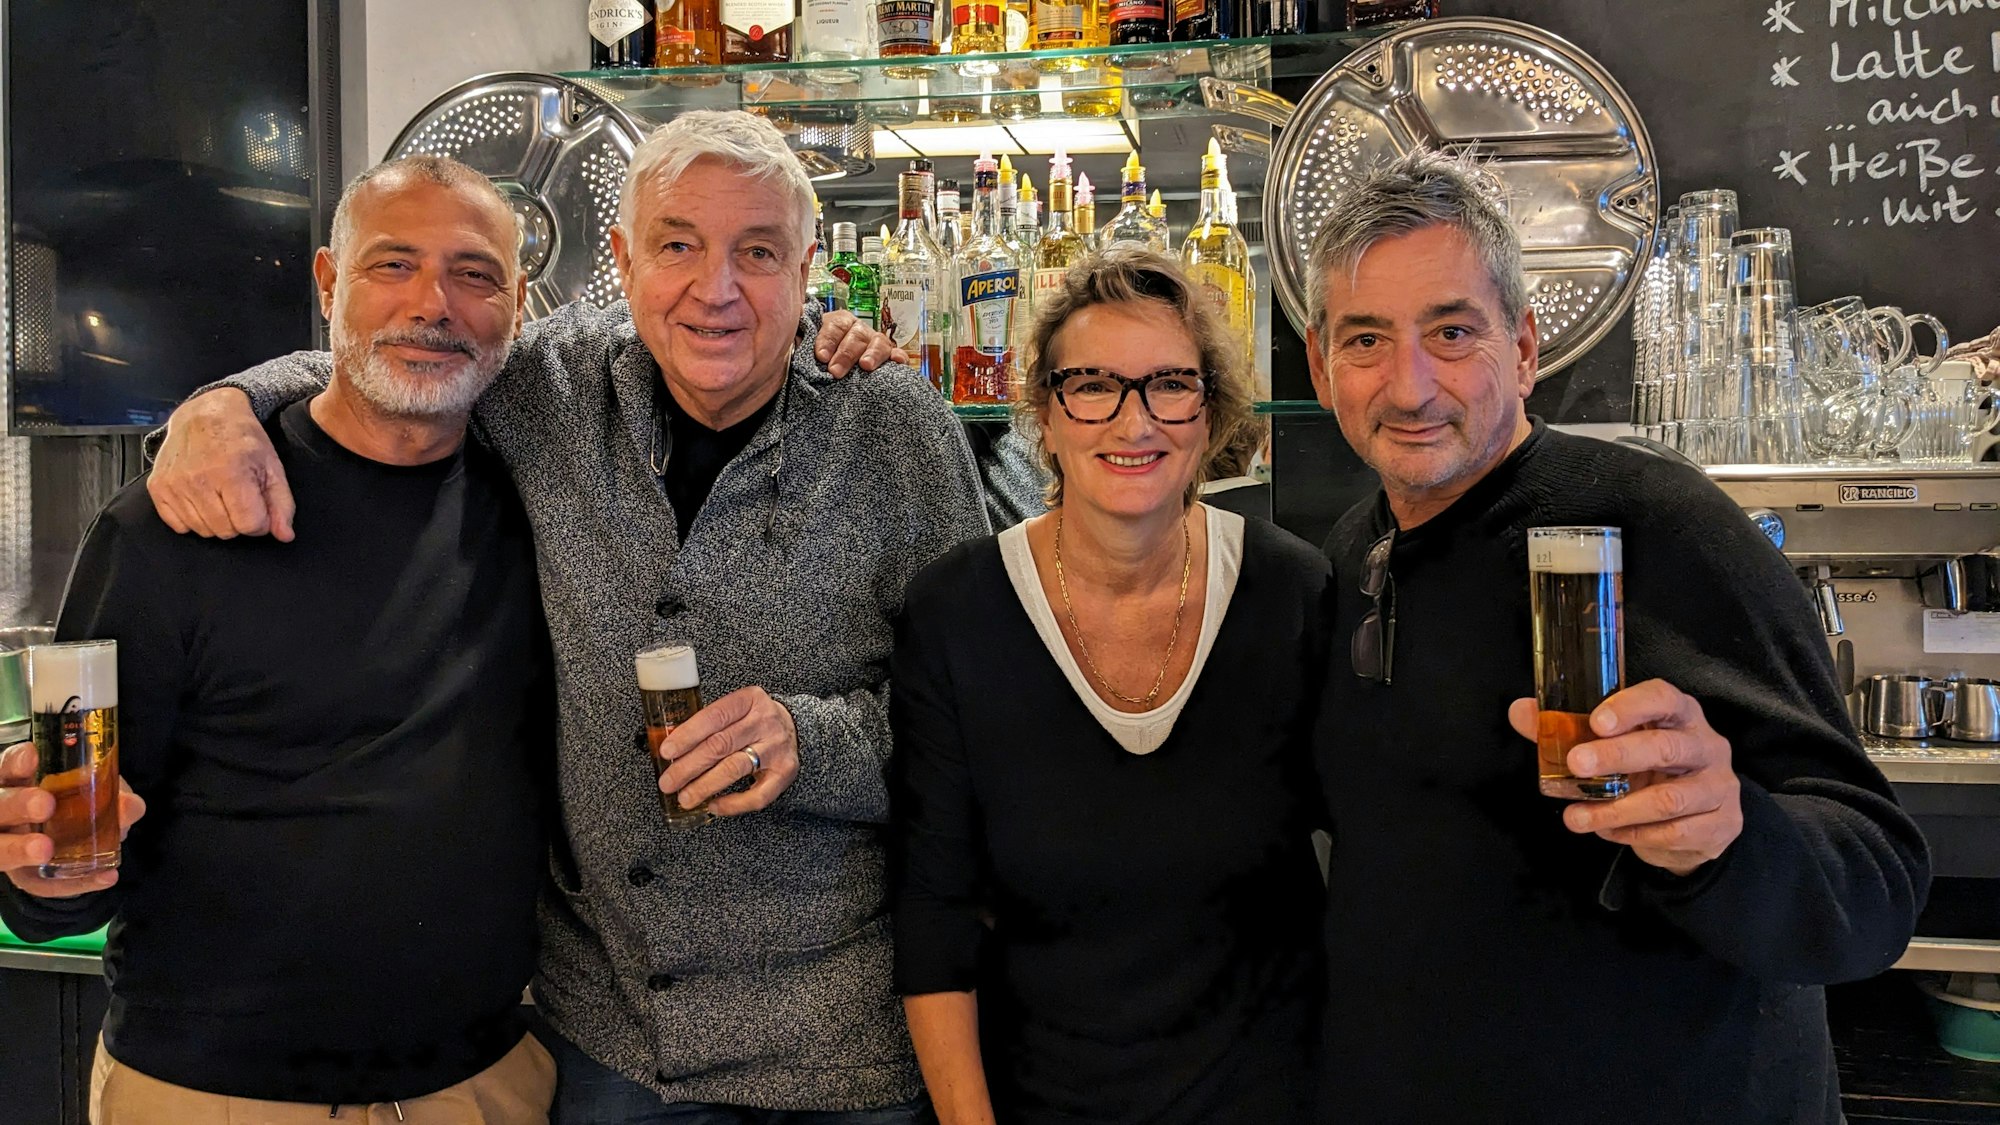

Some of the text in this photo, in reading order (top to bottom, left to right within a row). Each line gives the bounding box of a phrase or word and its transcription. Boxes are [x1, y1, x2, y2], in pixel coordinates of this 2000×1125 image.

[896, 1, 931, 13] MARTIN
[590, 8, 643, 20] ENDRICK'S
[1830, 30, 1975, 83] Latte
[887, 287, 916, 302] Morgan
[966, 276, 1017, 301] APEROL
[1861, 487, 1917, 499] RANCILIO
[1836, 590, 1876, 603] sse-6
